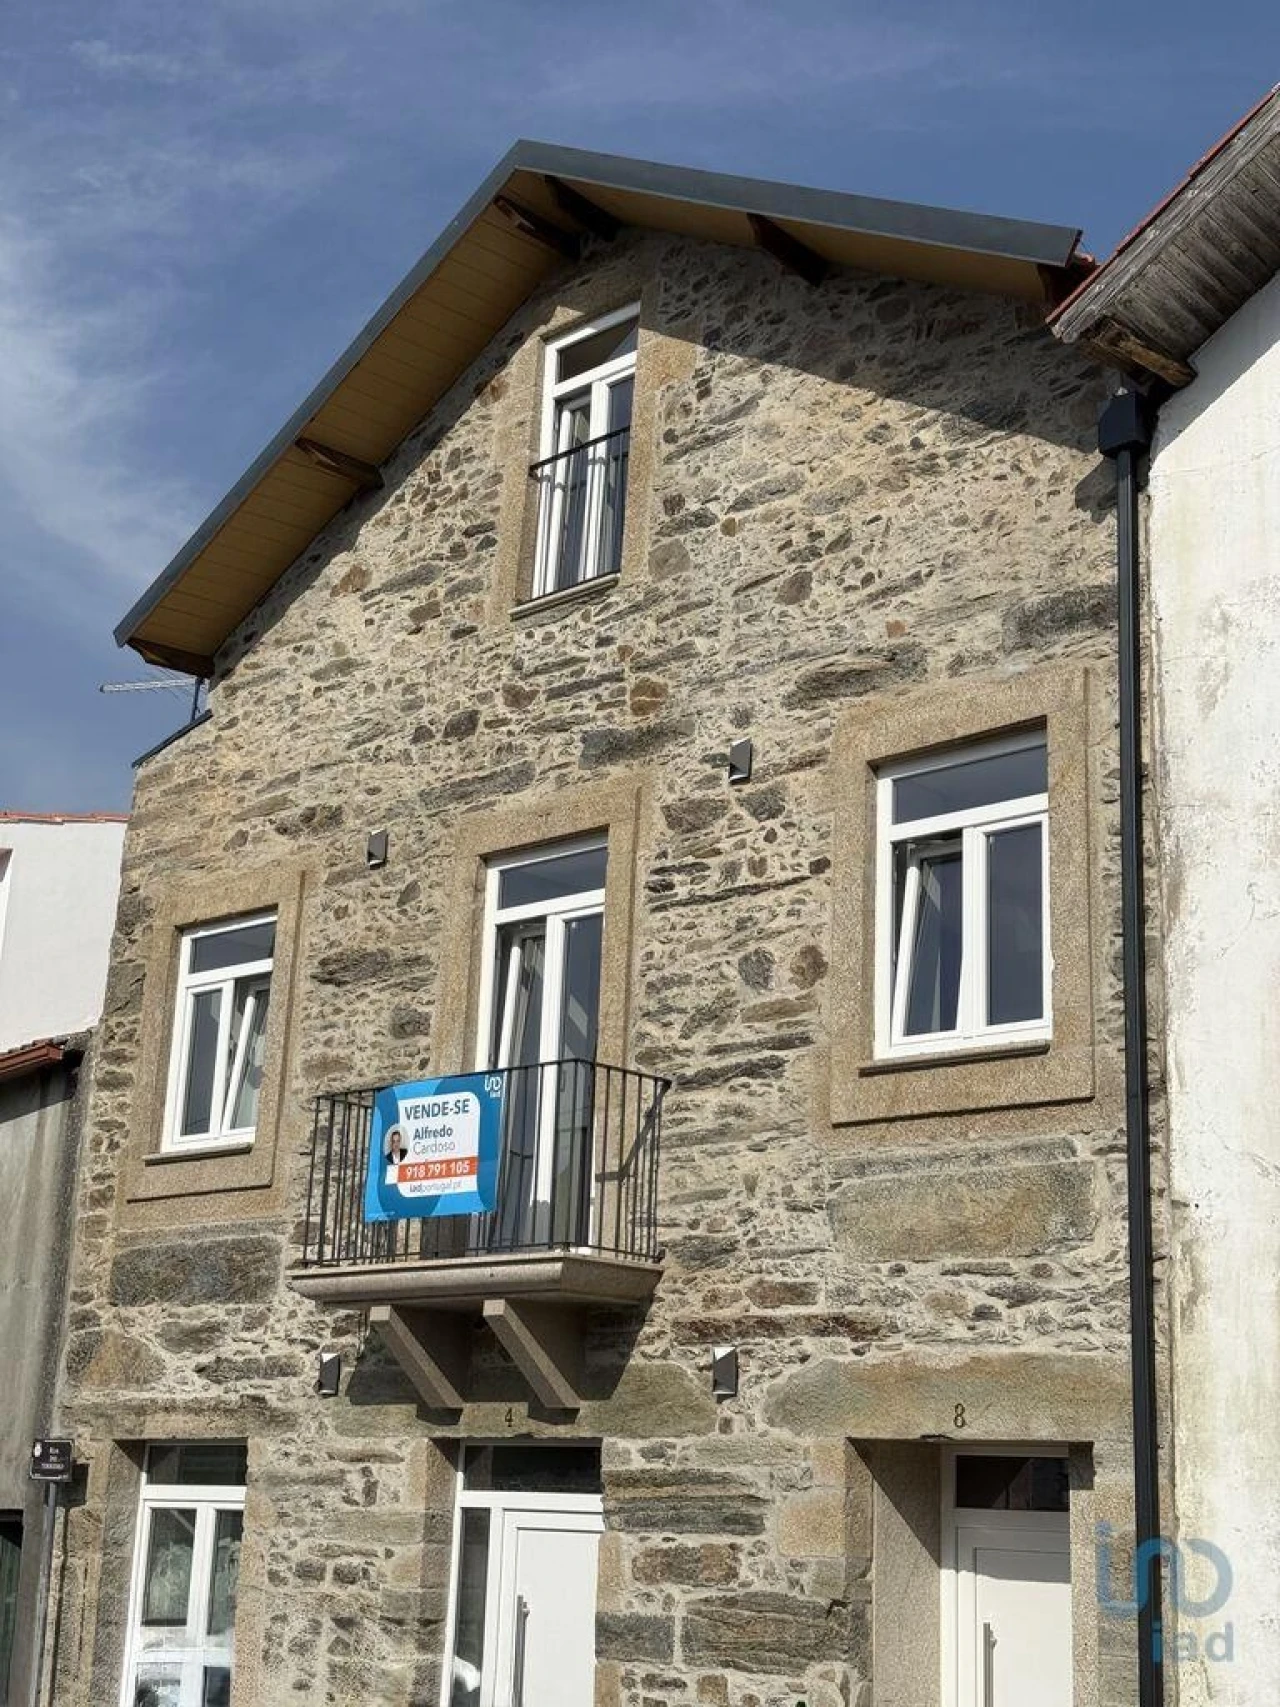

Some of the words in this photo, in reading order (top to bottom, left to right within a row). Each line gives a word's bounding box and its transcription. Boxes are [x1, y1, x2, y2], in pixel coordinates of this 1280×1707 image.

[404, 1098, 471, 1120] VENDE-SE
[413, 1124, 454, 1141] Alfredo
[413, 1141, 456, 1156] Cardoso
[406, 1165, 426, 1179] 918
[428, 1162, 447, 1177] 791
[450, 1160, 470, 1175] 105
[505, 1406, 514, 1428] 4
[954, 1403, 966, 1428] 8
